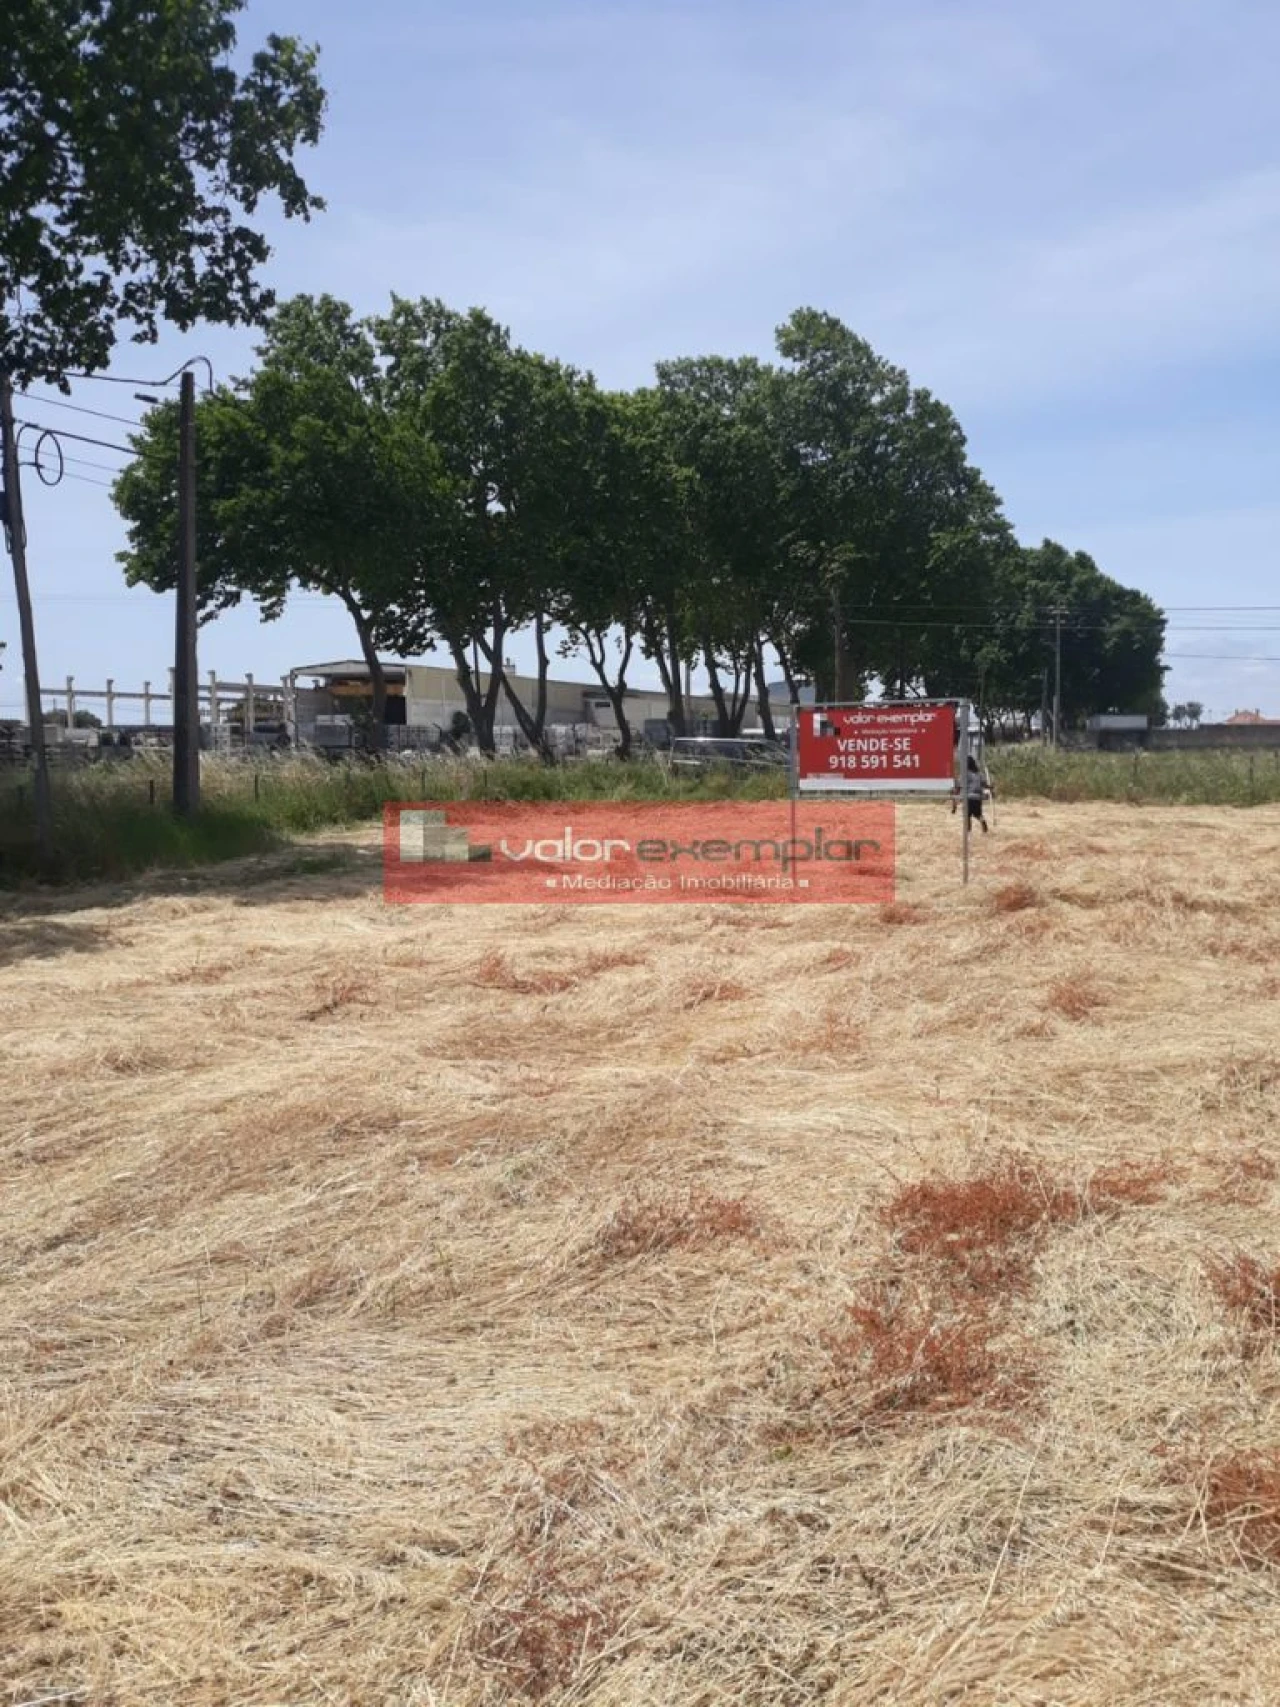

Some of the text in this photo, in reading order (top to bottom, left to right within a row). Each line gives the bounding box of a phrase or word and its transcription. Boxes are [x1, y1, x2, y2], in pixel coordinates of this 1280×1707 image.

[843, 710, 937, 726] valor exemplar
[837, 738, 911, 752] VENDE-SE
[829, 755, 920, 769] 918 591 541
